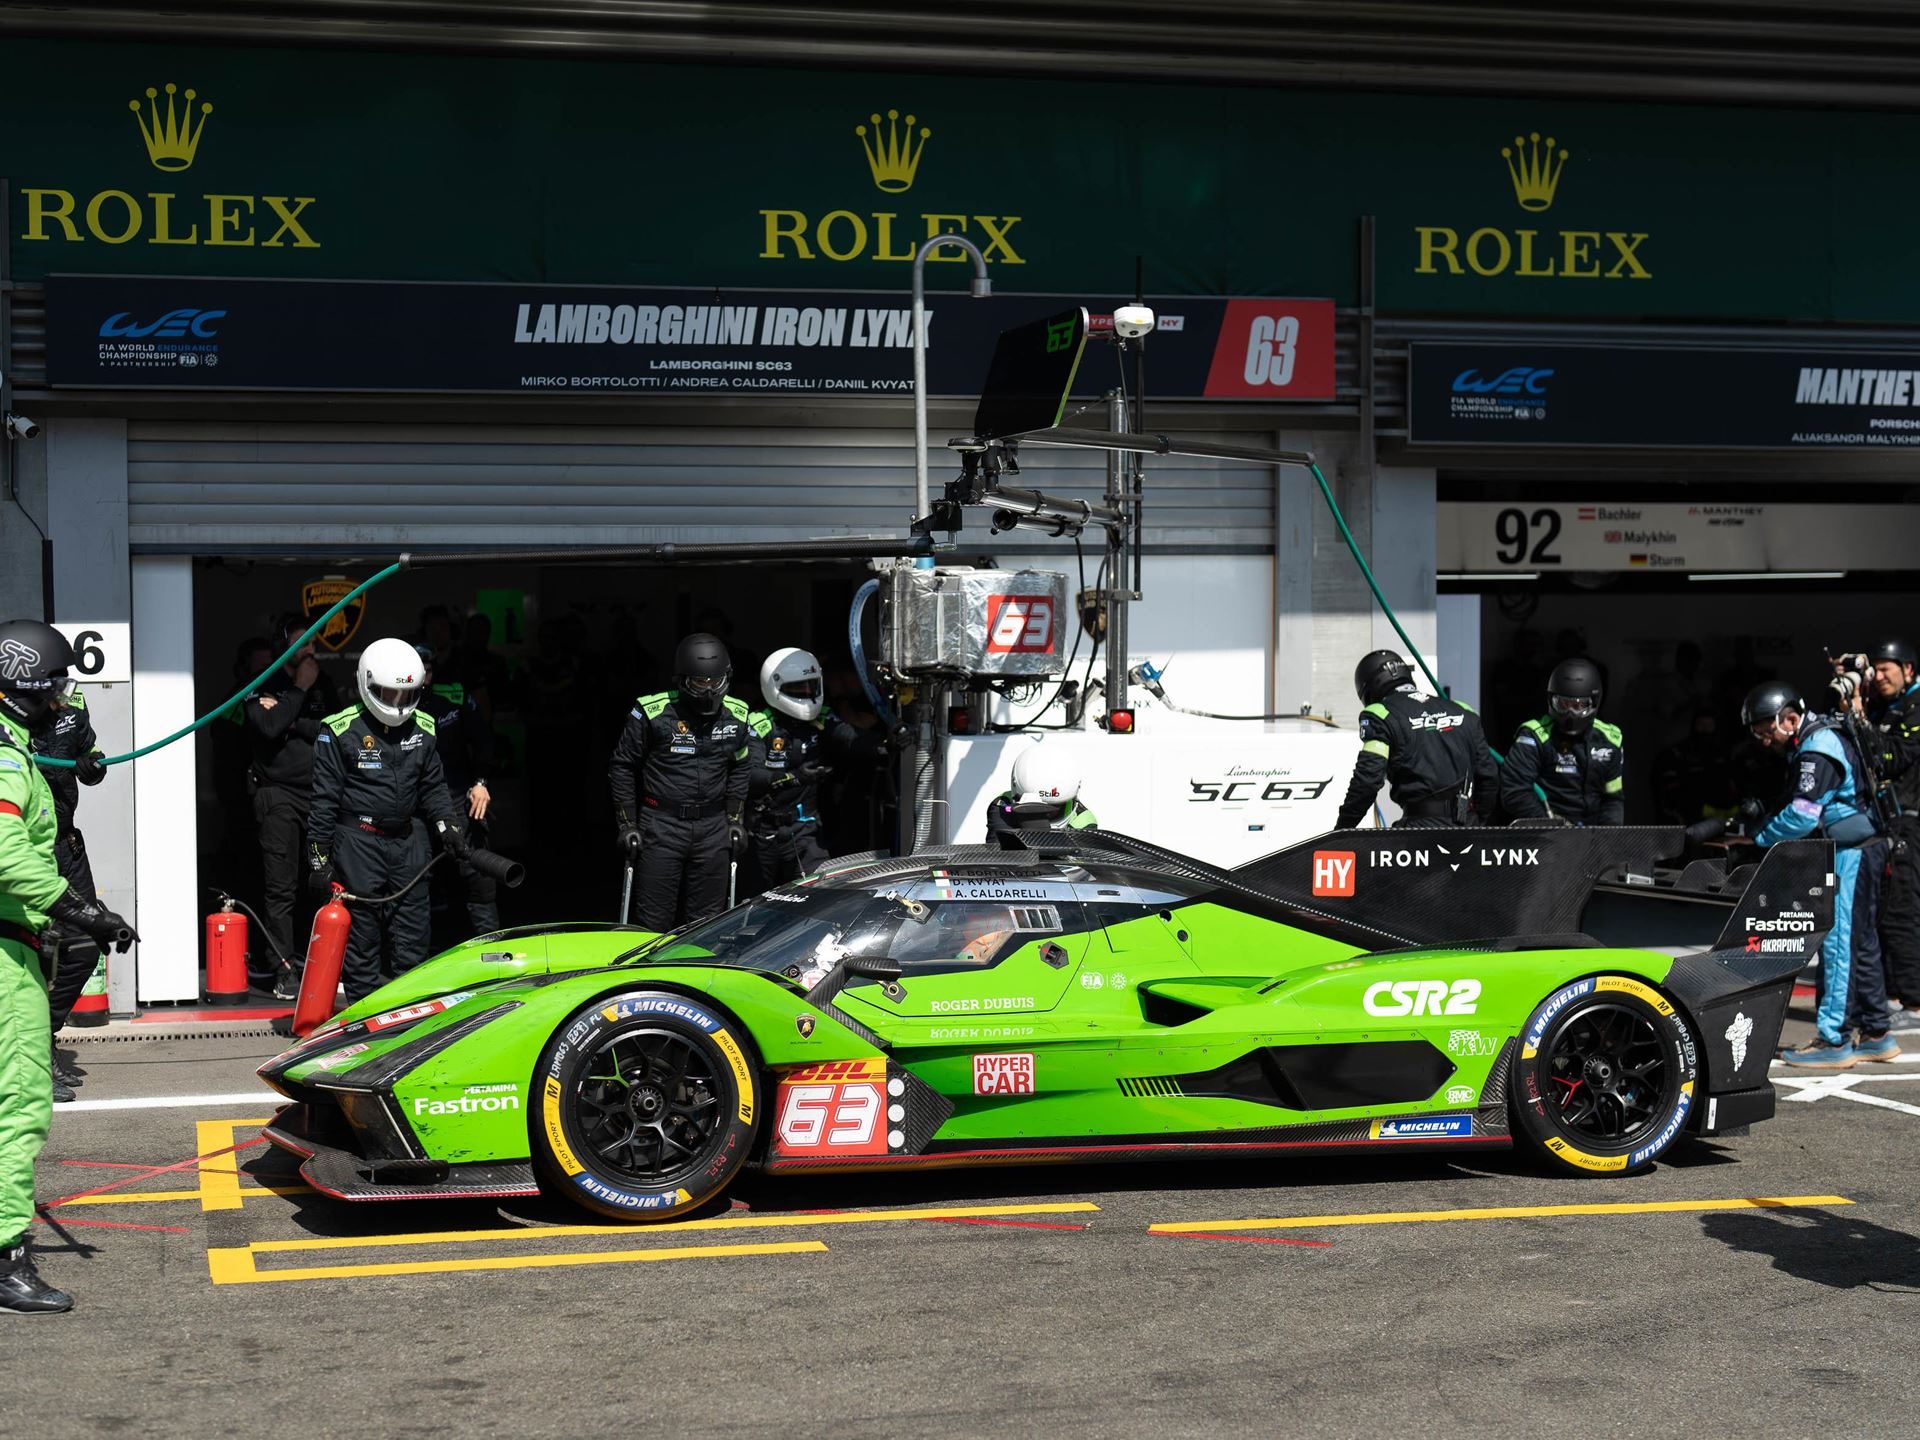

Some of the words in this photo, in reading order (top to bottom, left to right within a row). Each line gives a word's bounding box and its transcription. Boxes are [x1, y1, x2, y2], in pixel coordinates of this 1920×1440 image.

[22, 188, 320, 247] ROLEX
[760, 209, 1025, 264] ROLEX
[1415, 227, 1652, 279] ROLEX
[99, 309, 226, 337] WEC
[514, 303, 758, 345] LAMBORGHINI
[761, 307, 847, 347] IRON
[99, 352, 177, 360] CHAMPIONSHIP
[158, 344, 218, 352] ENDURANCE
[1243, 315, 1299, 386] 63
[650, 360, 753, 370] LAMBORGHINI
[756, 361, 793, 371] SC63
[521, 376, 568, 386] MIRKO
[571, 377, 660, 387] BORTOLOTTI
[670, 378, 729, 388] ANDREA
[732, 378, 815, 388] CALDARELLI
[825, 379, 869, 389] DANIIL
[871, 380, 915, 390] KVYAT
[1451, 367, 1555, 394] WEC
[1451, 404, 1514, 413] CHAMPIONSHIP
[1467, 397, 1497, 405] WORLD
[1598, 507, 1642, 521] Bachler
[1495, 508, 1562, 566] 92
[1623, 529, 1677, 546] Malykhin
[1648, 554, 1685, 566] Sturm
[990, 601, 1052, 647] 63
[1224, 765, 1292, 779] Lamborghini
[1370, 850, 1430, 868] IRON
[1480, 848, 1540, 866] LYNX
[1315, 858, 1353, 889] HY
[968, 878, 1006, 886] KVYAT
[955, 889, 967, 898] A.
[970, 889, 1048, 899] CALDARELLI
[1779, 911, 1815, 919] PERTAMINA
[1745, 917, 1815, 932] Fastron
[1622, 982, 1644, 993] SPORT
[930, 999, 980, 1012] ROGER
[983, 997, 1035, 1009] DUBUIS
[1362, 978, 1482, 1017] CSR2
[634, 1001, 713, 1028] MICHELIN
[1534, 981, 1589, 1035] MICHELIN
[1656, 1001, 1670, 1012] M
[719, 1035, 737, 1057] PILOT
[733, 1056, 748, 1082] SPORT
[976, 1056, 1031, 1072] HYPER
[786, 1062, 873, 1081] DHL
[464, 1083, 518, 1095] PERTAMINA
[546, 1083, 559, 1099] M
[976, 1072, 1031, 1095] CAR
[414, 1095, 519, 1116] Fastron
[741, 1103, 752, 1118] M
[778, 1083, 882, 1147] 63
[550, 1121, 562, 1148] SPORT
[1398, 1121, 1461, 1132] MICHELIN
[1634, 1106, 1685, 1163] MICHELIN
[1550, 1140, 1565, 1152] M
[559, 1149, 575, 1169] PILOT
[1579, 1157, 1601, 1167] SPORT
[1603, 1160, 1623, 1168] PILOT
[581, 1177, 660, 1208] MICHELIN
